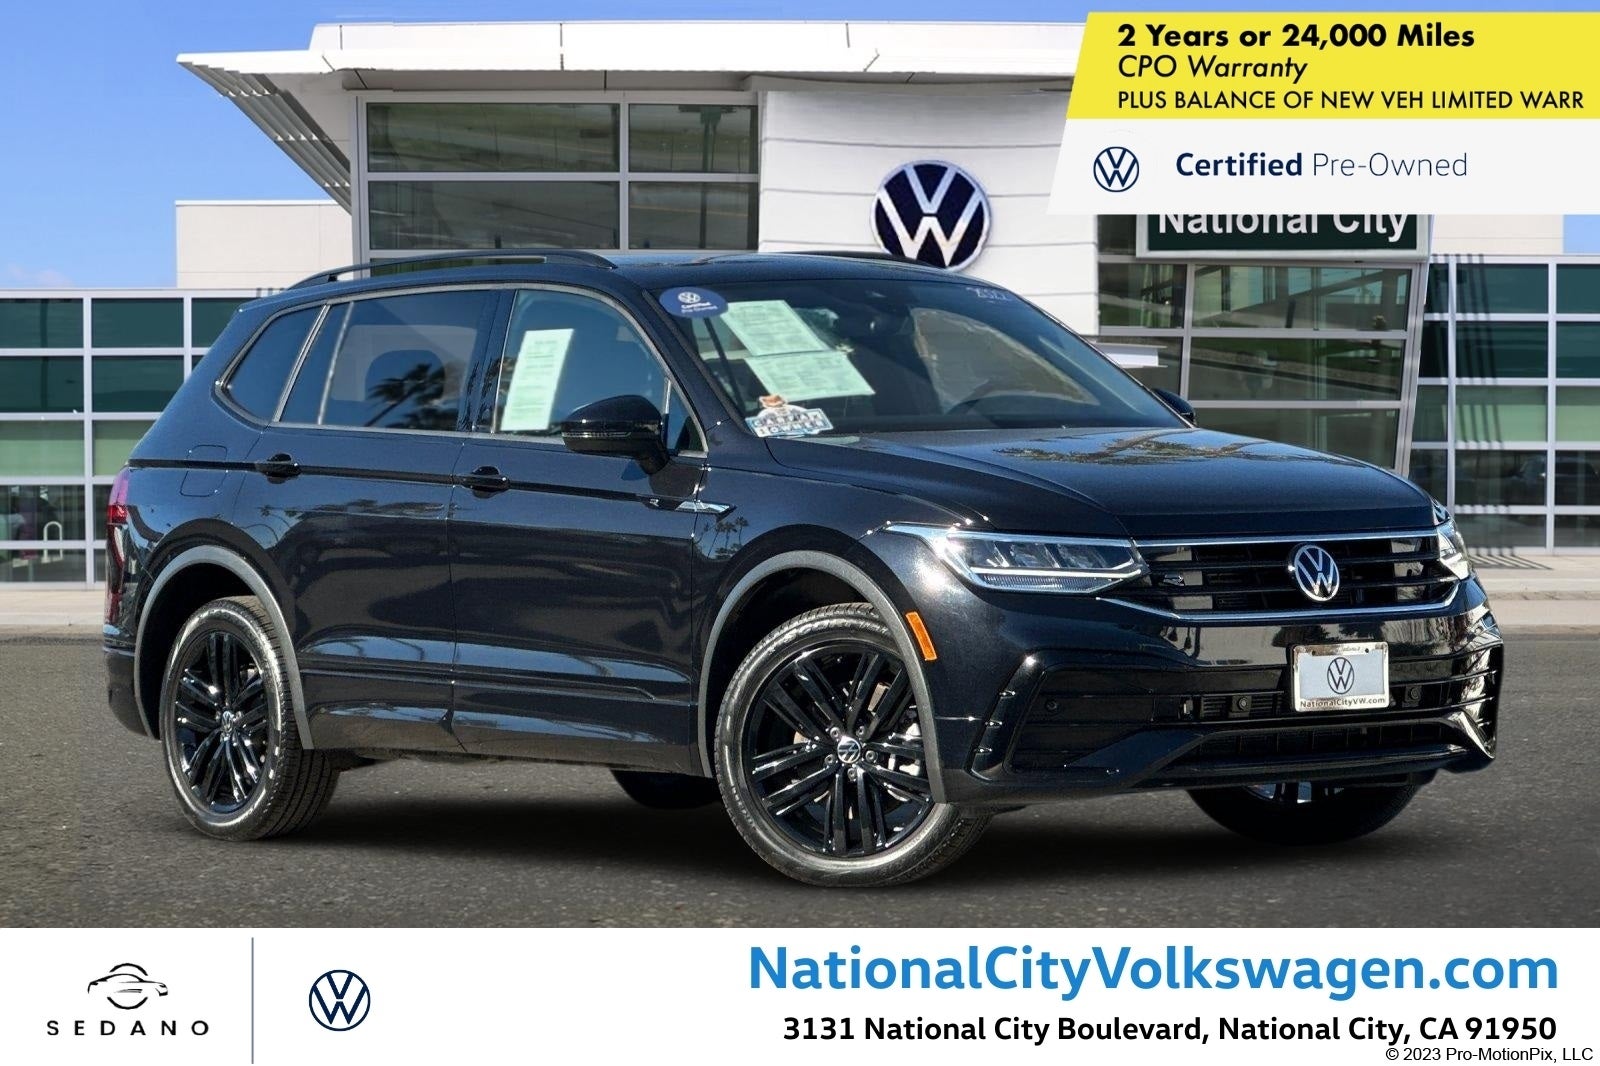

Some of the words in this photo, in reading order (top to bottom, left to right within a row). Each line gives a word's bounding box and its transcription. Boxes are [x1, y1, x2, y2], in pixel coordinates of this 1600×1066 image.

[1158, 213, 1319, 234] National
[1332, 213, 1409, 243] City
[1300, 697, 1386, 709] NationalCityVW.com
